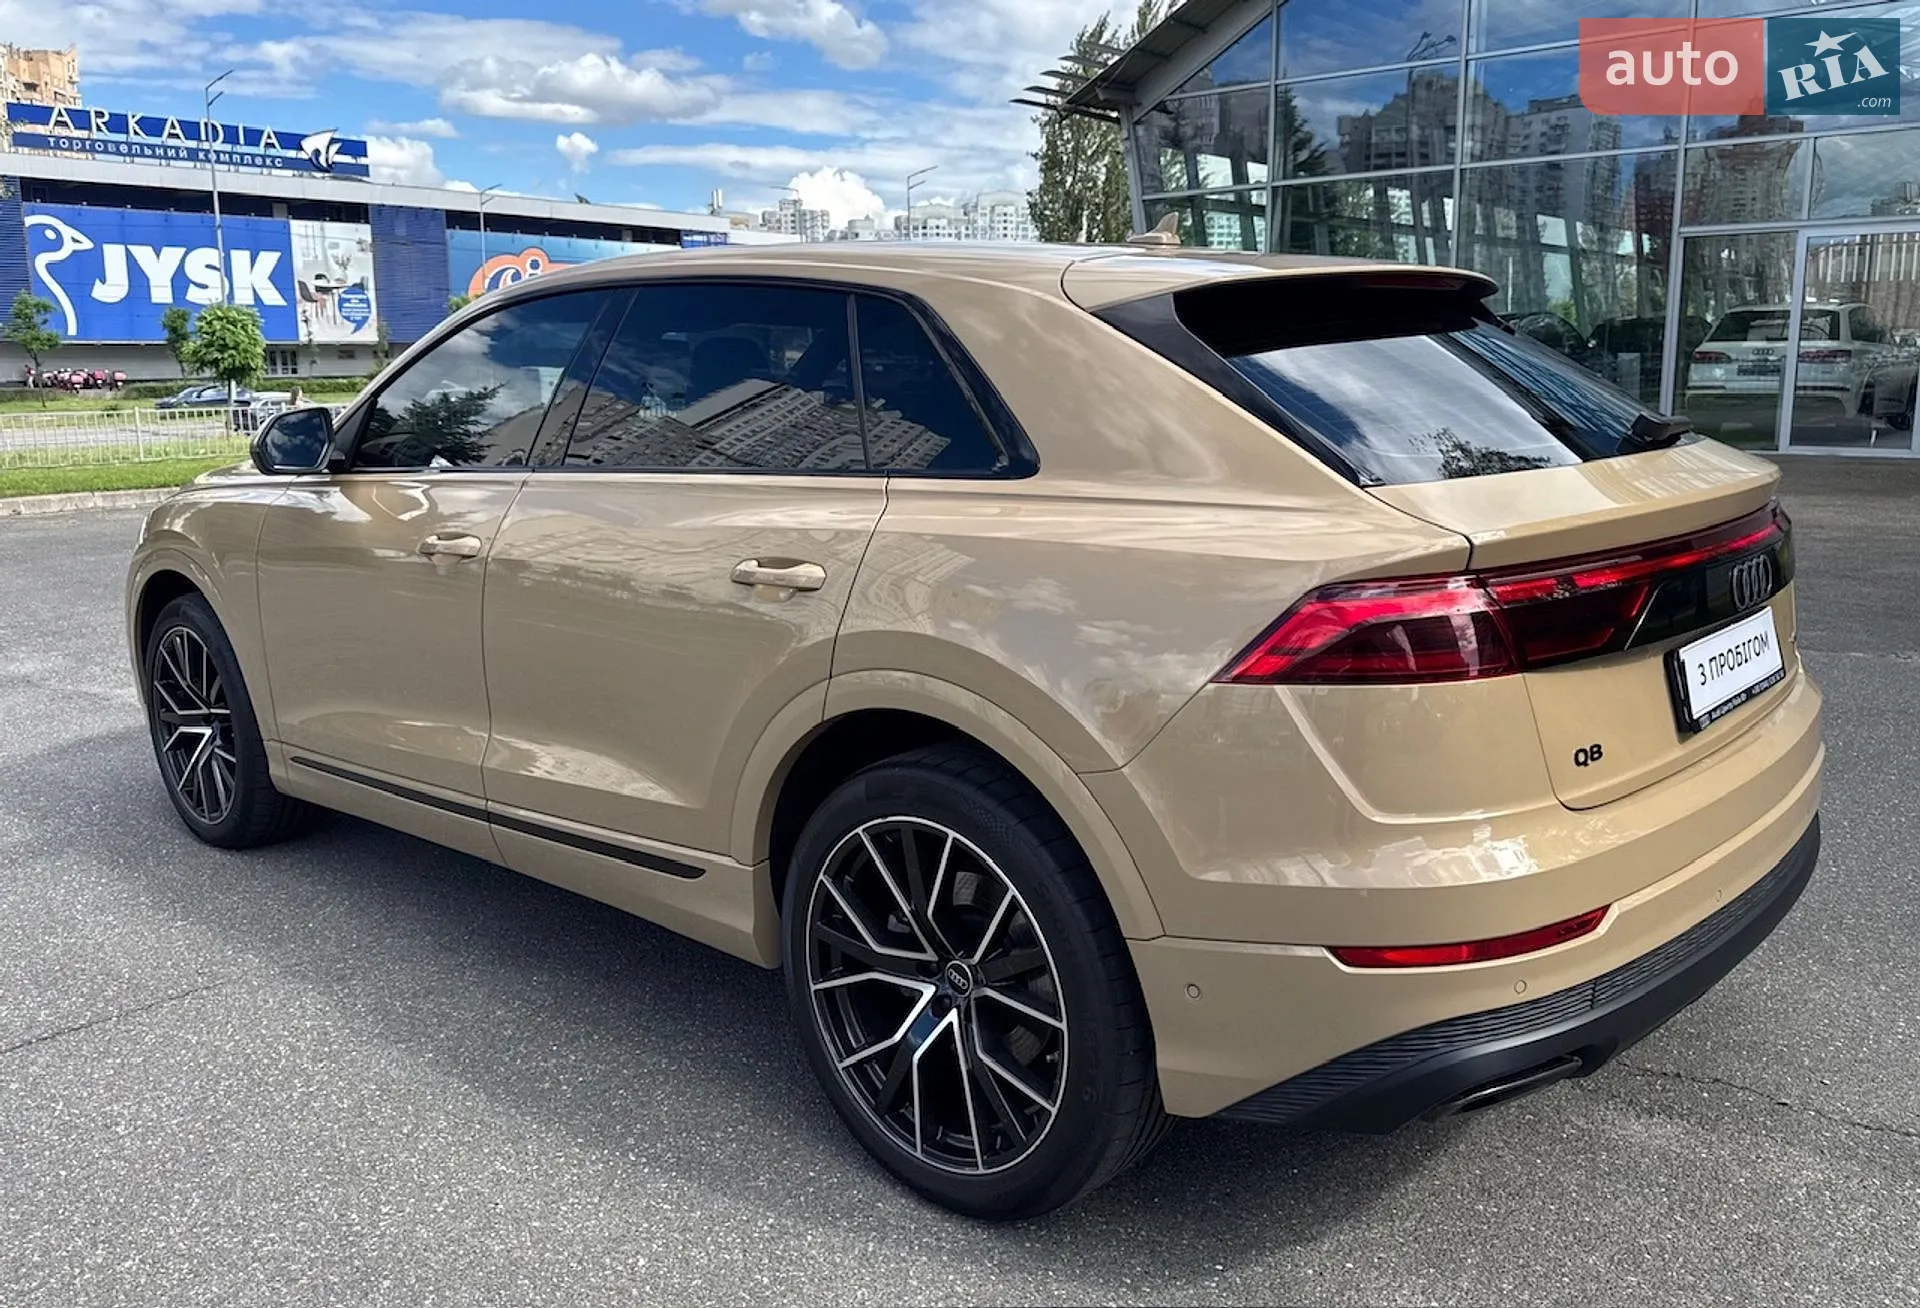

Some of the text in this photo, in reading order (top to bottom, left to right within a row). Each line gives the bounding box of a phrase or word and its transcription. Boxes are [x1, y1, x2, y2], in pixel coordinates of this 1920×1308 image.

[47, 136, 188, 159] торговельний
[48, 106, 283, 153] ARKADIA
[91, 243, 288, 306] JYSK
[1708, 630, 1771, 681] ПРОБІГОМ
[1573, 743, 1604, 768] Q8
